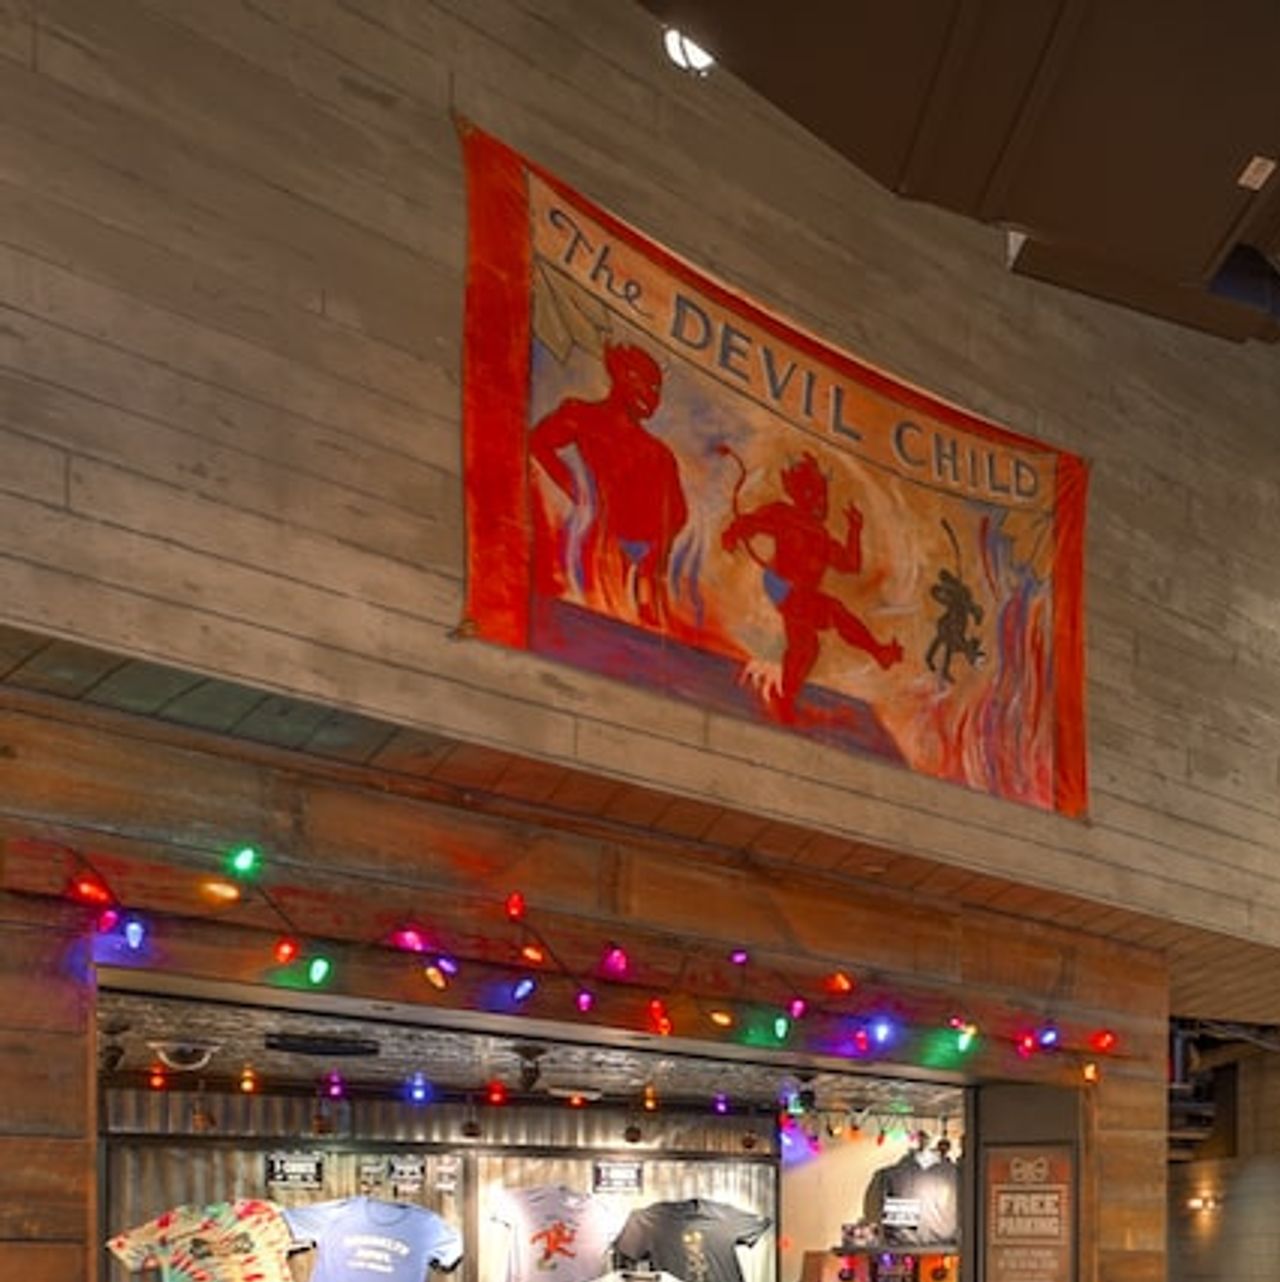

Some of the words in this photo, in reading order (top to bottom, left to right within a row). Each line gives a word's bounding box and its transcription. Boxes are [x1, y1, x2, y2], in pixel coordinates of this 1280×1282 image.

[548, 207, 645, 308] The
[672, 290, 864, 443] DEVIL
[893, 421, 1039, 500] CHILD
[998, 1193, 1059, 1215] FREE
[998, 1216, 1059, 1237] PARKING
